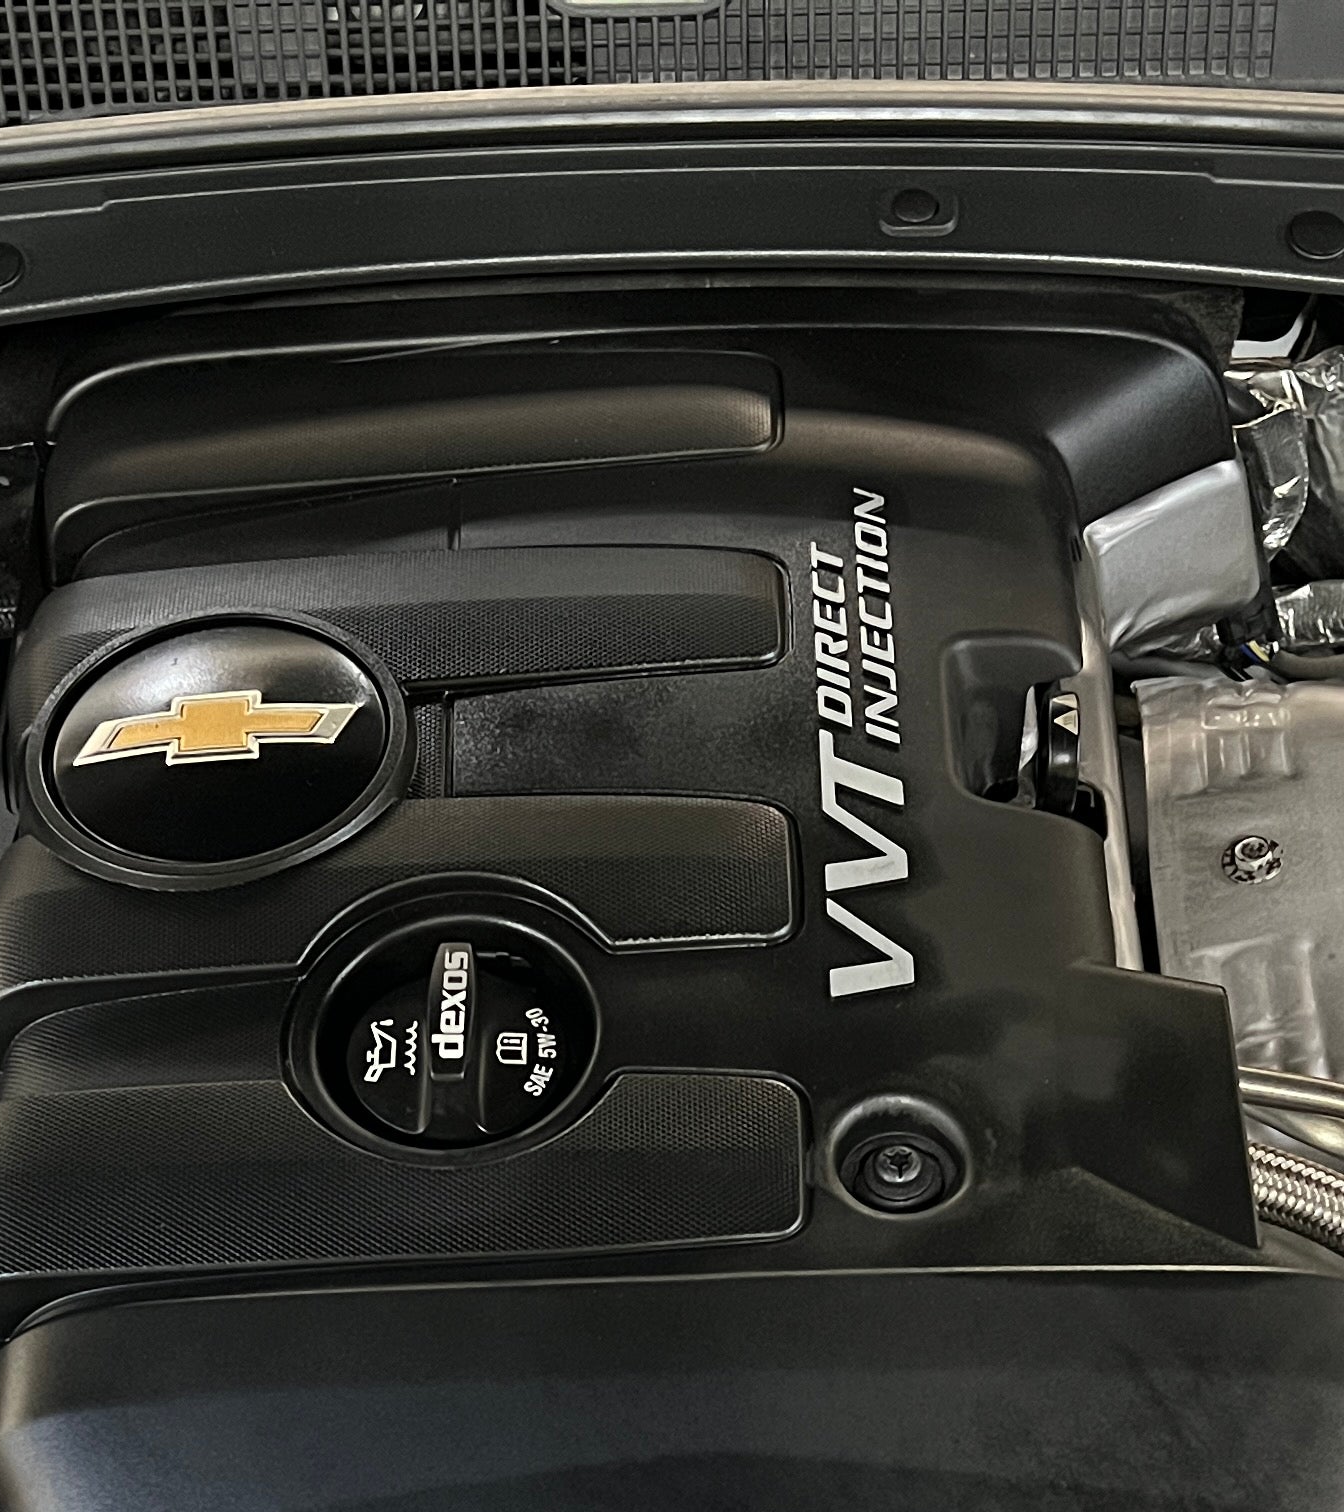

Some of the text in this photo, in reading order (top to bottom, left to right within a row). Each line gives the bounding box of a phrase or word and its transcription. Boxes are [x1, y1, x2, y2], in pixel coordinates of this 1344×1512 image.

[810, 541, 853, 728] DIRECT
[853, 487, 902, 744] INJECTION
[818, 728, 915, 998] VVT
[431, 951, 469, 1059] dexos
[523, 1007, 557, 1097] SAE 5W-30
